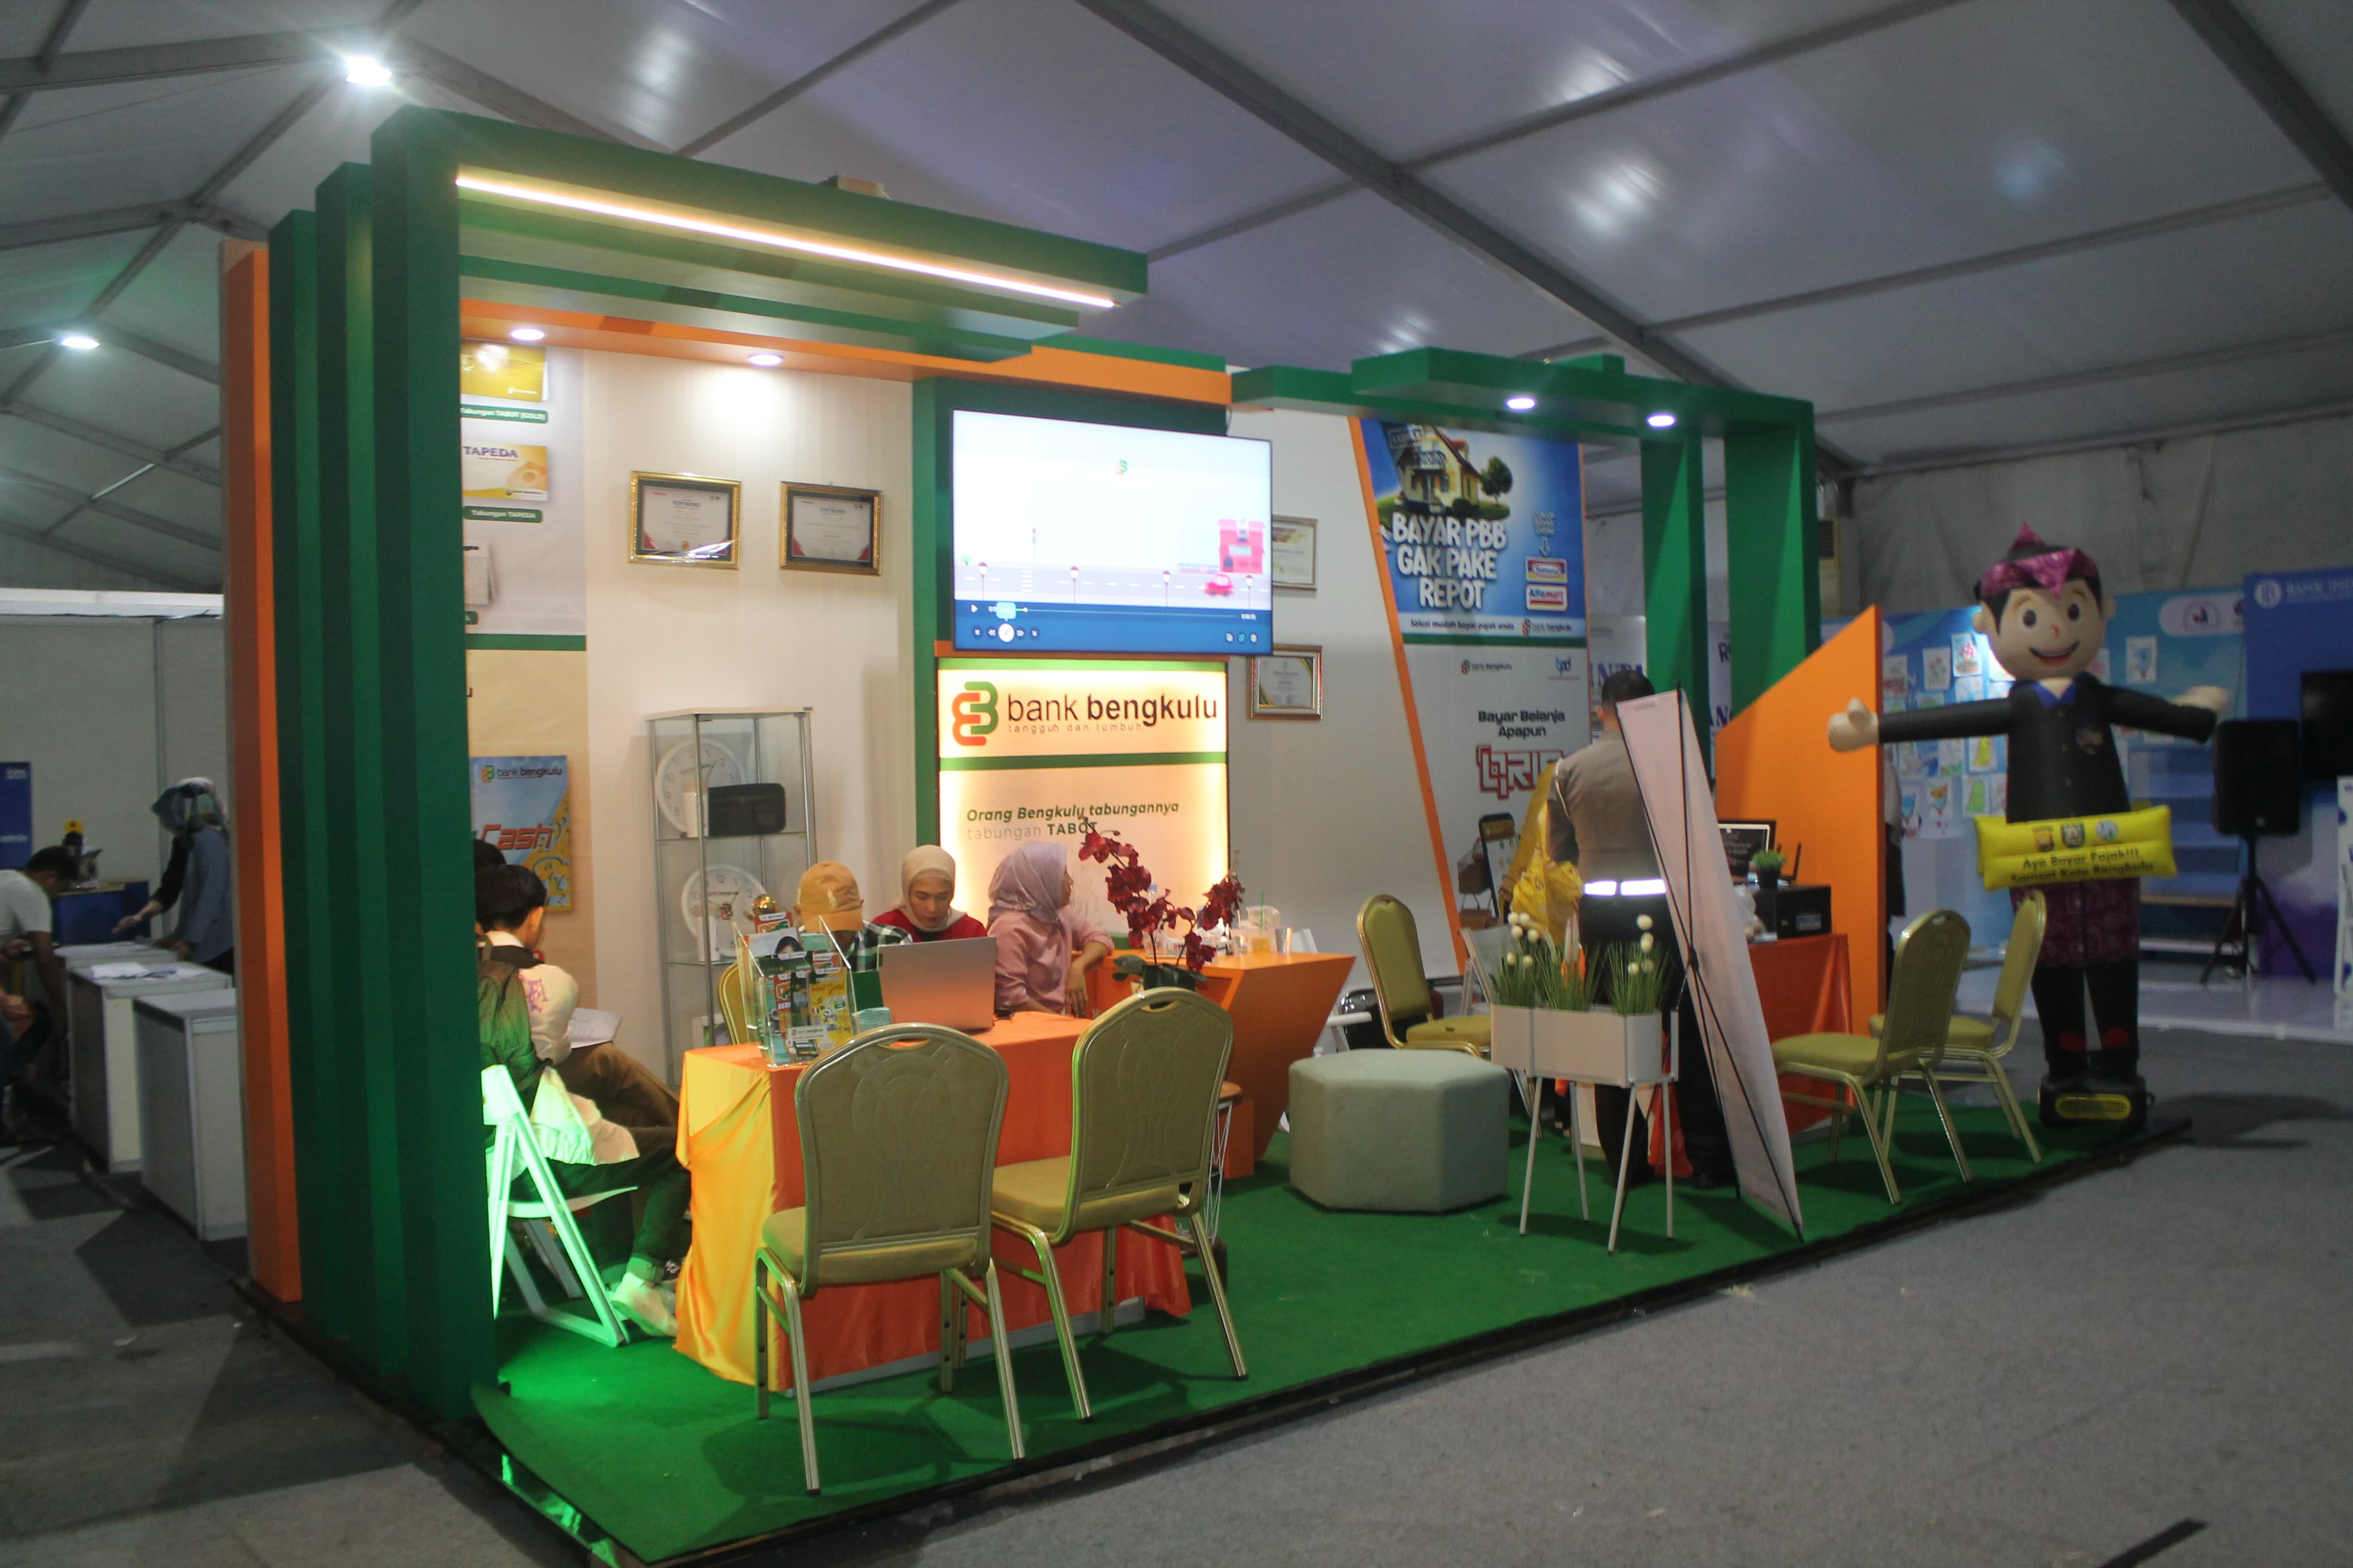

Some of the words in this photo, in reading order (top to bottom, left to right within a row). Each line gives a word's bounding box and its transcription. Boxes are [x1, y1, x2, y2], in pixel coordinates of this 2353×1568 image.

[463, 446, 519, 458] TAPEDA
[1391, 512, 1461, 547] BAYAR
[1466, 520, 1508, 551] PBB
[1397, 547, 1442, 577] GAK
[1446, 549, 1498, 580] PAKE
[1419, 578, 1486, 611] REPOT
[1007, 694, 1079, 722] bank
[1088, 693, 1217, 727] bengkulu
[1478, 710, 1518, 725] Bayar
[1520, 709, 1566, 724] Belanja
[1067, 723, 1089, 732] dan
[1498, 726, 1547, 740] Apapun
[497, 768, 518, 777] bank
[520, 767, 562, 777] bengkulu
[967, 809, 1014, 823] Orang
[1018, 806, 1085, 821] Bengkulu
[1088, 802, 1180, 817] tabungannya
[481, 823, 553, 851] Cash
[967, 824, 1042, 841] tabungan
[1046, 822, 1098, 837] TABOT
[2023, 858, 2046, 871] Ayo
[2050, 854, 2087, 867] Bayar
[2091, 847, 2140, 863] Pajak!!!
[2059, 868, 2089, 880] Kota
[2093, 862, 2154, 876] Bengkulu
